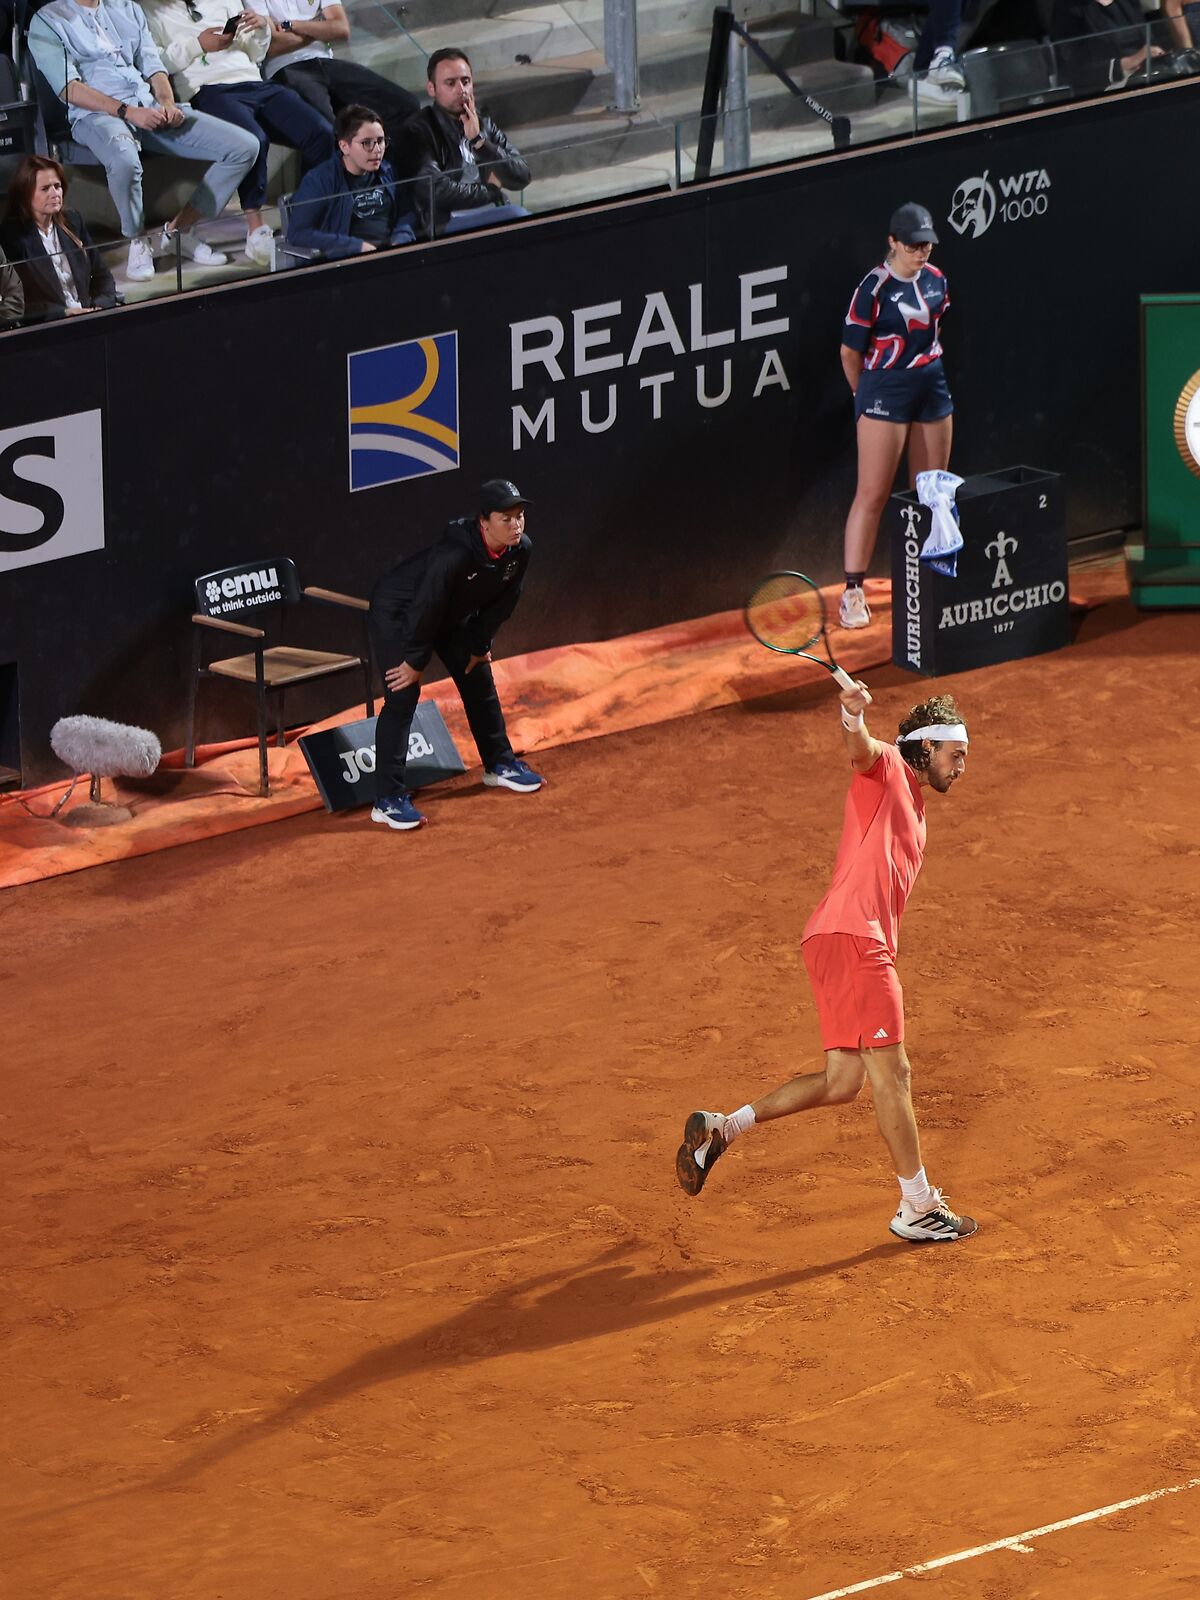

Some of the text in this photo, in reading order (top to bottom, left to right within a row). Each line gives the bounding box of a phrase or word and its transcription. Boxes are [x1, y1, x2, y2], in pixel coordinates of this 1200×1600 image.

[999, 168, 1051, 198] WTA
[999, 194, 1048, 223] 1000
[509, 265, 790, 391] REALE
[511, 349, 791, 451] MUTUA
[1039, 494, 1048, 508] 2
[221, 567, 279, 597] emu
[991, 558, 1013, 589] A
[209, 590, 281, 615] we think outside
[905, 540, 921, 669] AURICCHIO
[938, 580, 1066, 631] AURICCHIO
[993, 620, 1015, 634] 1877
[338, 731, 434, 784] Joa
